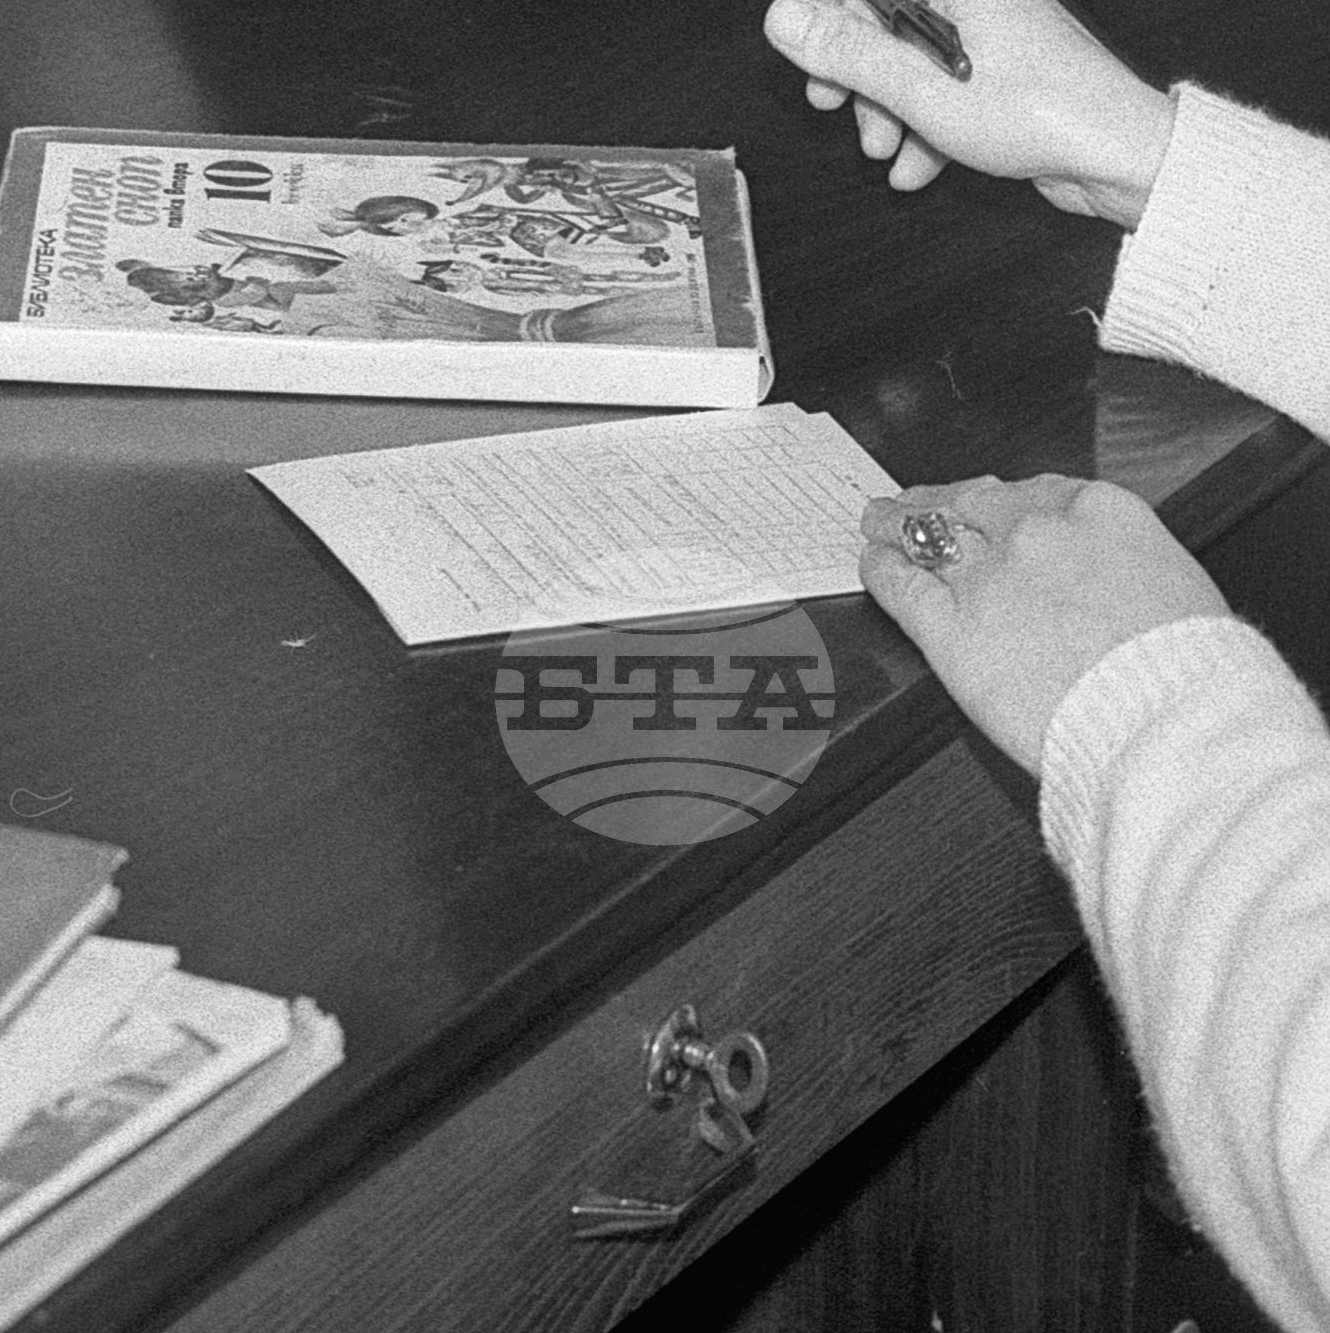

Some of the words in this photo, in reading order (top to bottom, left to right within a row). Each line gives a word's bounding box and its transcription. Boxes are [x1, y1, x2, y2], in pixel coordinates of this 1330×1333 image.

[115, 155, 163, 226] сноп
[203, 160, 274, 202] 10
[27, 228, 58, 318] БИБЛИОТЕКА
